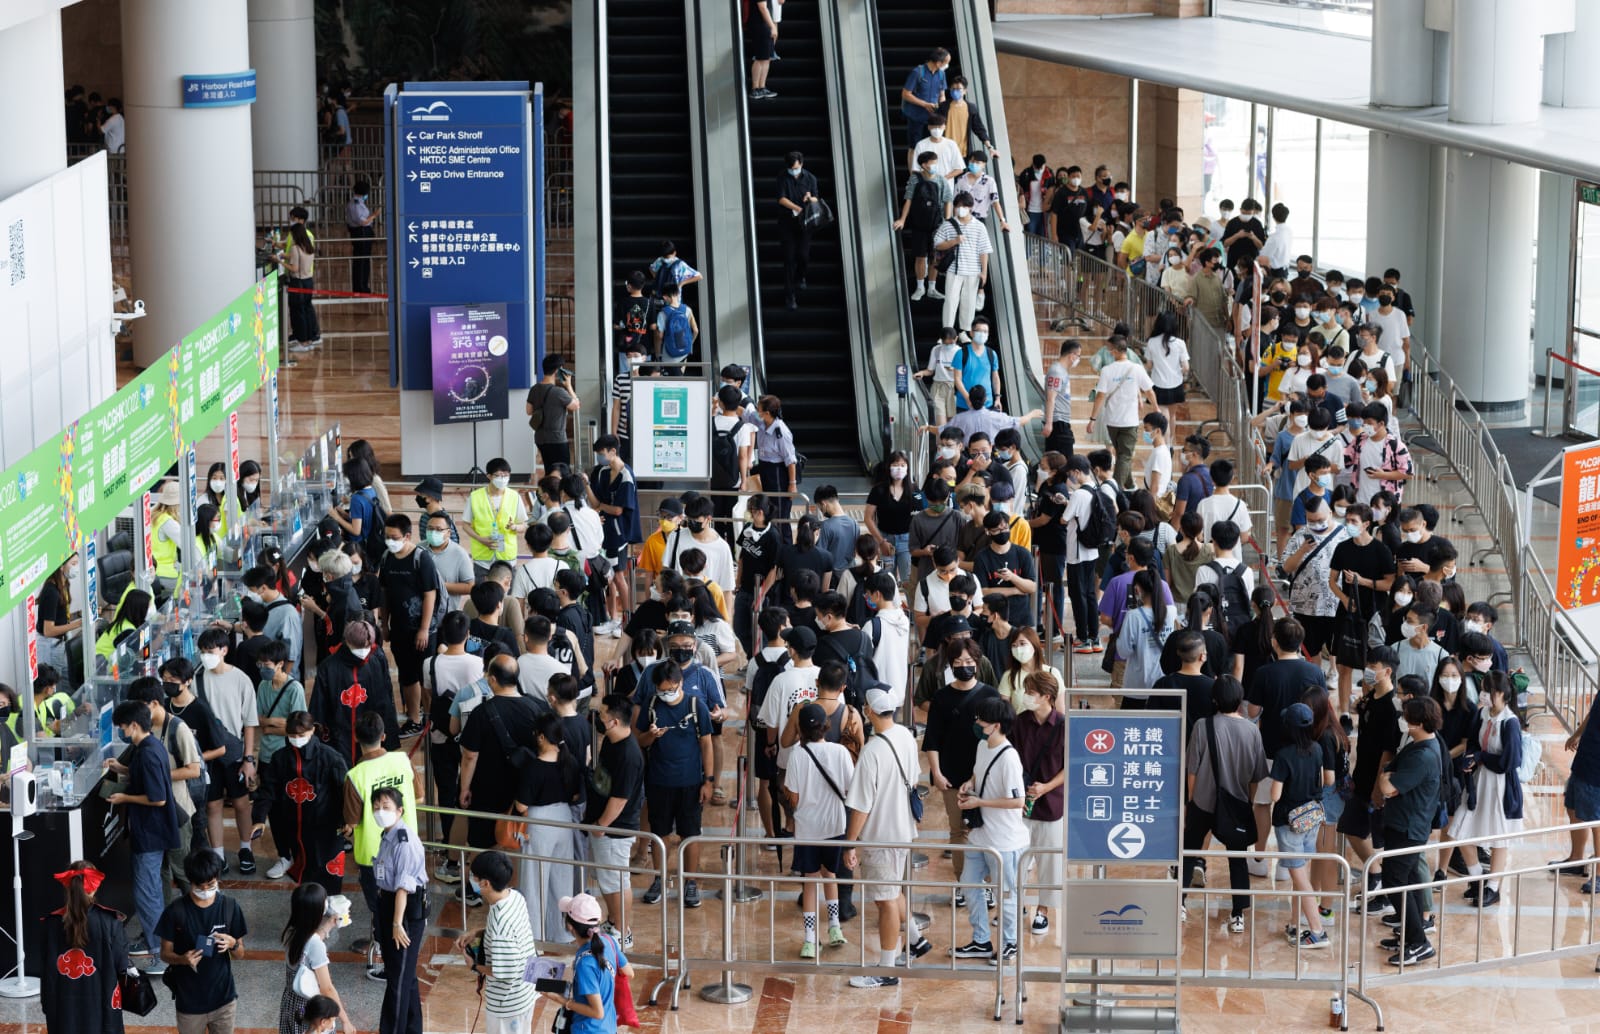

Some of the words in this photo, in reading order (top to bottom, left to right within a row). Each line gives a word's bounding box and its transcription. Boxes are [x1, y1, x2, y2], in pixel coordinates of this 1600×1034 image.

[201, 82, 227, 91] Harbour
[419, 131, 434, 140] Car
[437, 131, 455, 140] Park
[458, 131, 483, 140] Shroff
[420, 146, 447, 155] HKCEC
[449, 146, 498, 155] Administration
[499, 145, 520, 154] Office
[420, 156, 447, 164] HKTDC
[448, 156, 465, 164] SME
[467, 156, 491, 164] Centre
[420, 170, 441, 180] Expo
[443, 170, 465, 178] Drive
[467, 170, 504, 178] Entrance
[1048, 376, 1060, 388] 28
[1577, 516, 1589, 524] END
[1590, 514, 1598, 522] OF
[1124, 727, 1163, 742] 港鐵
[1123, 743, 1164, 756] MTR
[1123, 760, 1162, 776] 渡輪
[1122, 777, 1165, 792] Ferry
[1123, 795, 1161, 810] 巴士
[1122, 811, 1155, 823] Bus
